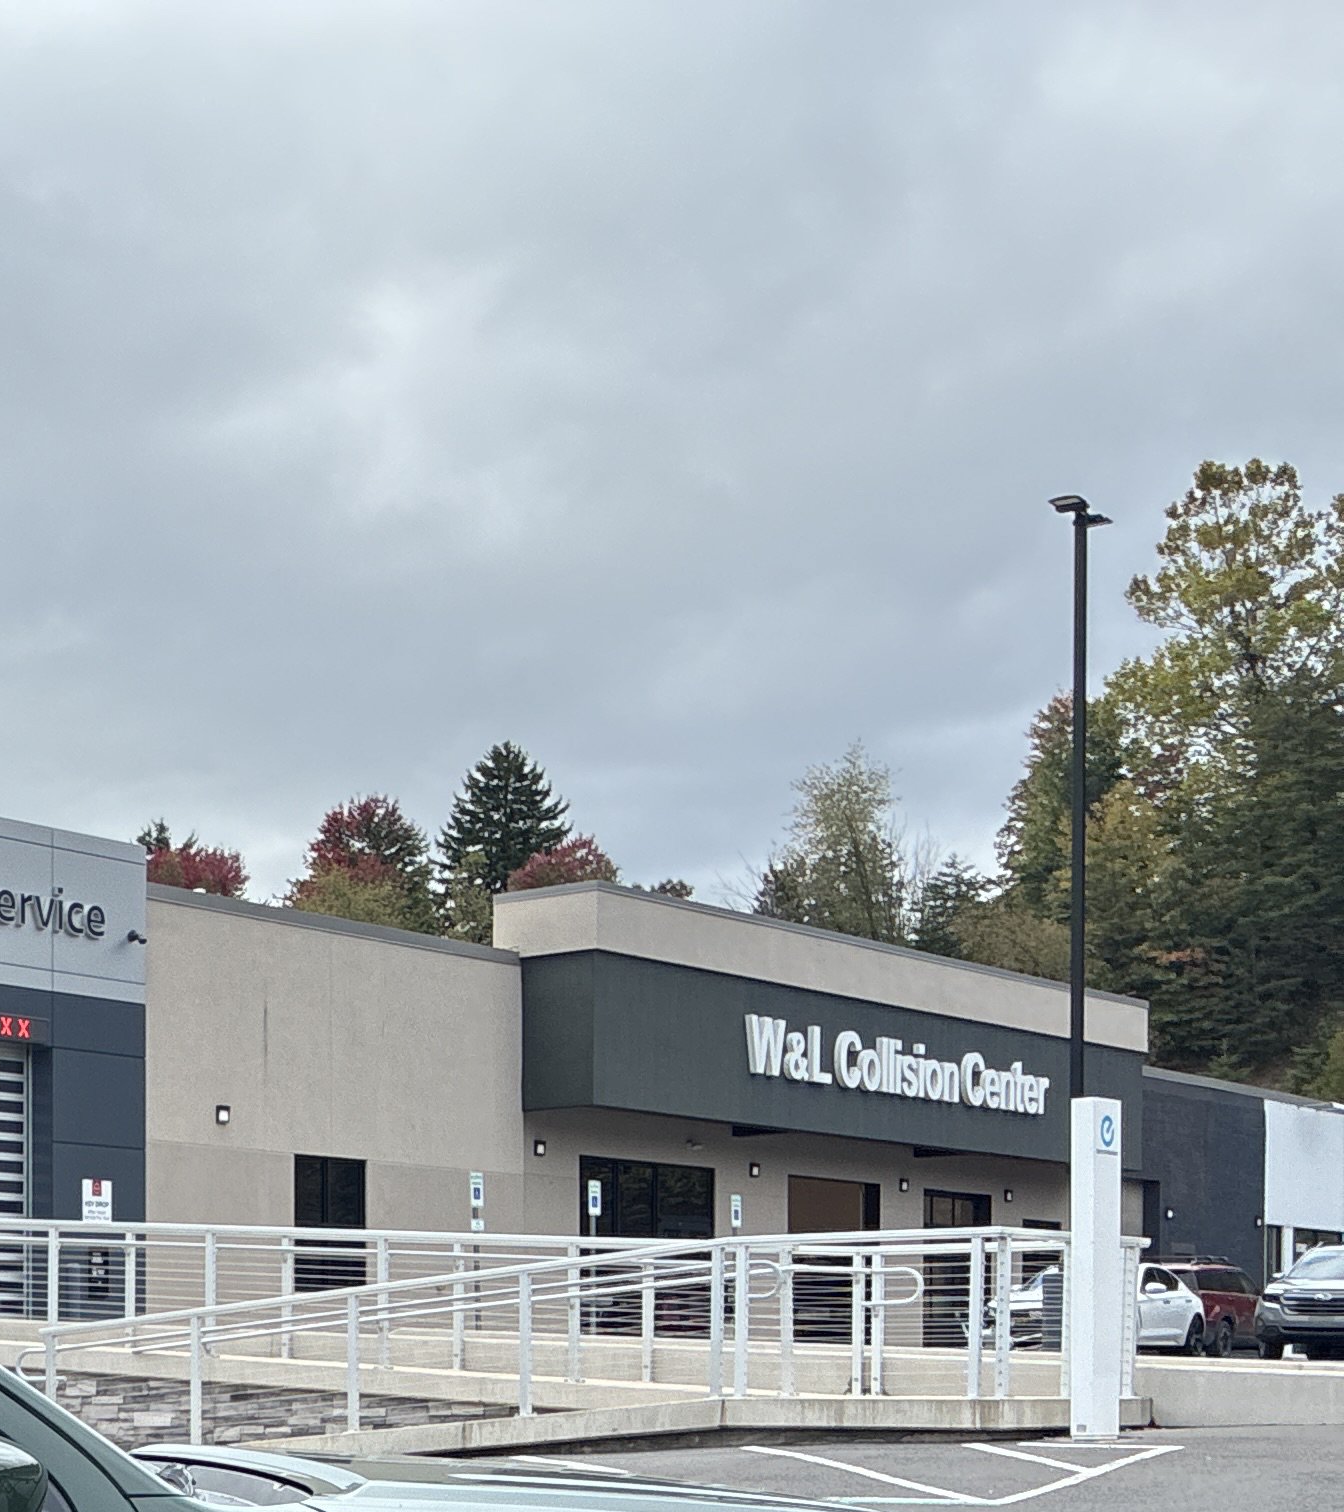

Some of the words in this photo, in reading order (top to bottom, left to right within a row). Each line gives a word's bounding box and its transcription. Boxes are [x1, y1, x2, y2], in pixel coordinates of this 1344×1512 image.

[744, 1013, 833, 1085] W&L
[833, 1030, 960, 1104] Collision
[961, 1052, 1050, 1115] Center
